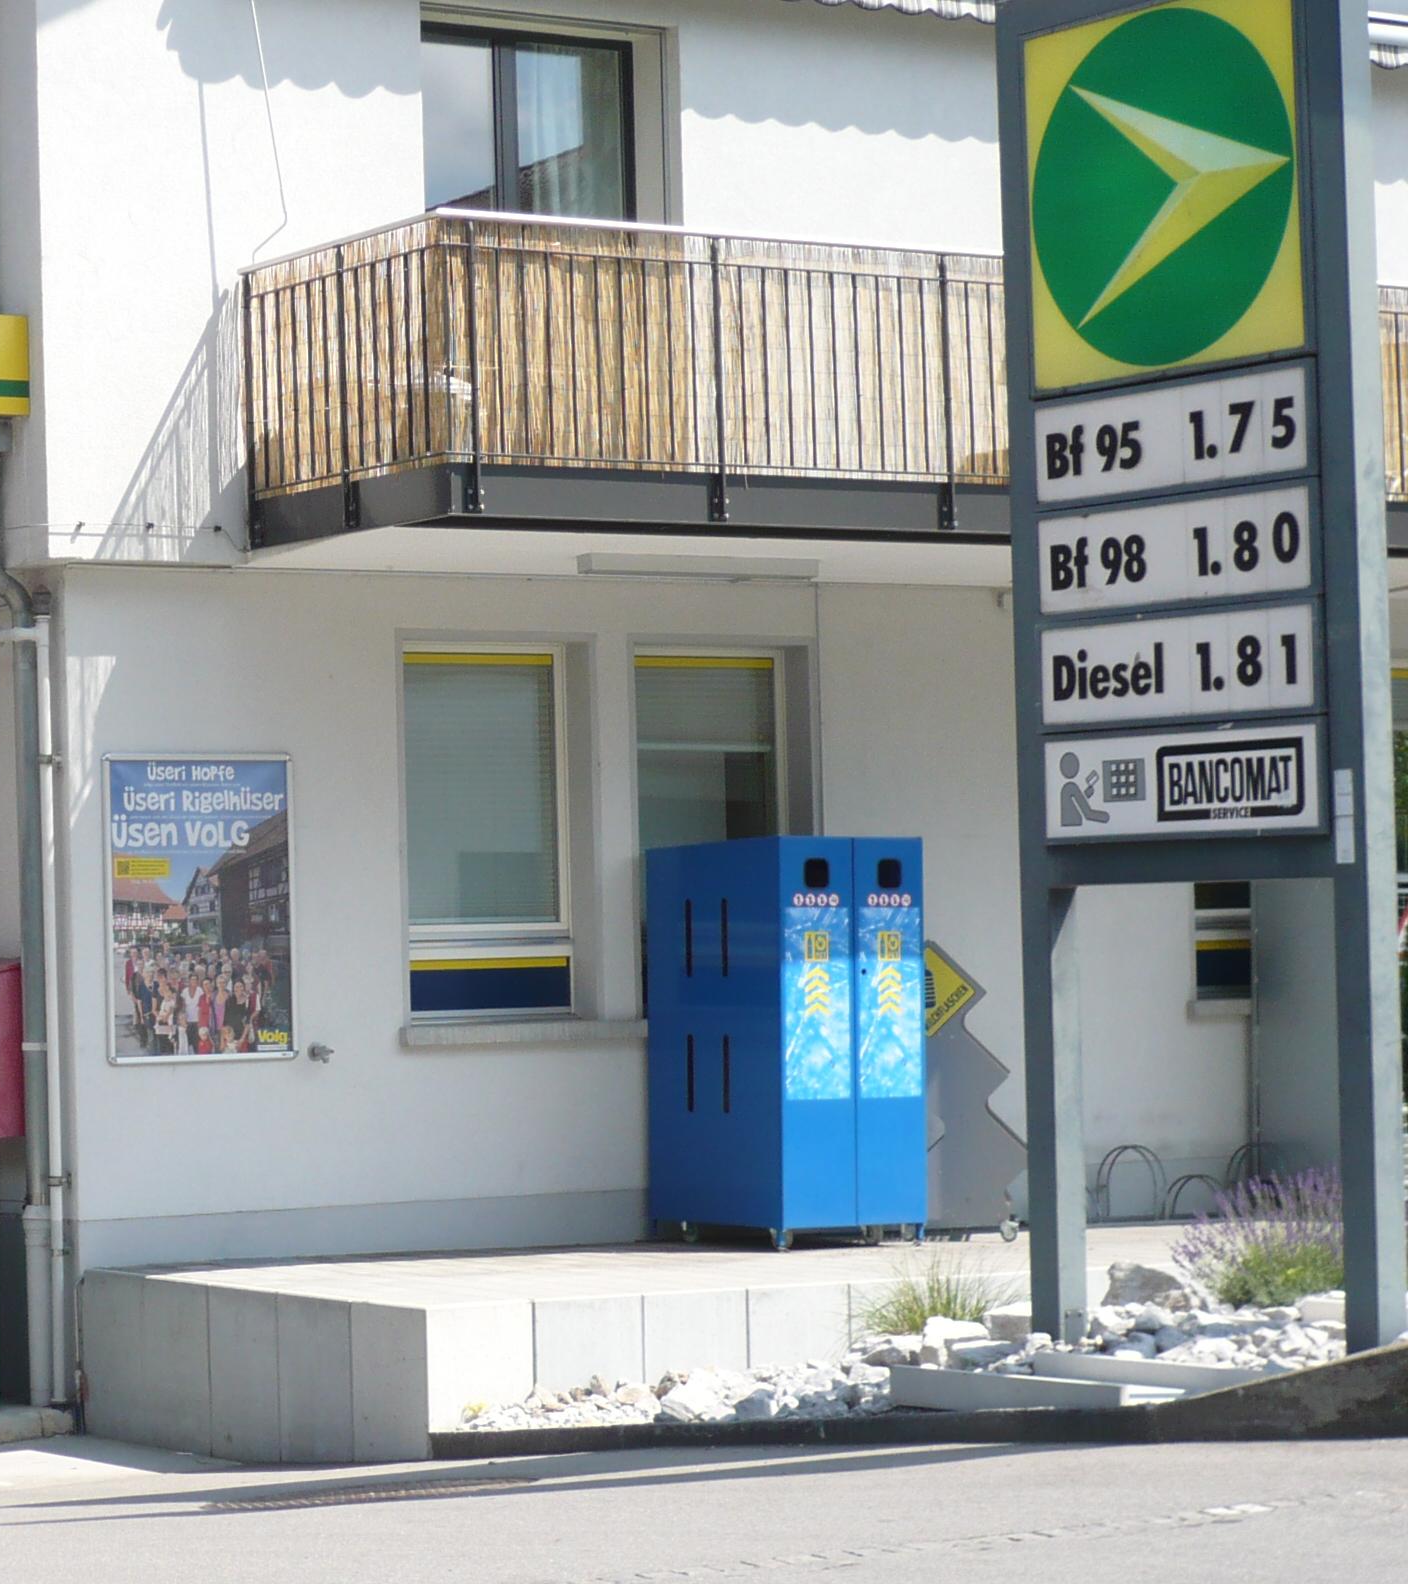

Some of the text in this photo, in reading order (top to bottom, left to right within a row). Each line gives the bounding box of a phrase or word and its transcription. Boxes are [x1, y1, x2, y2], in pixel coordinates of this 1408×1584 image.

[1046, 396, 1296, 480] Bf 95 1.75
[1050, 511, 1300, 592] Bf 98 1.80
[1052, 633, 1298, 701] Diesel 1.81
[1168, 754, 1292, 806] BANCOMAT
[111, 813, 179, 848] Üsen
[1212, 807, 1250, 820] SERVICE
[256, 1029, 289, 1046] Volg
